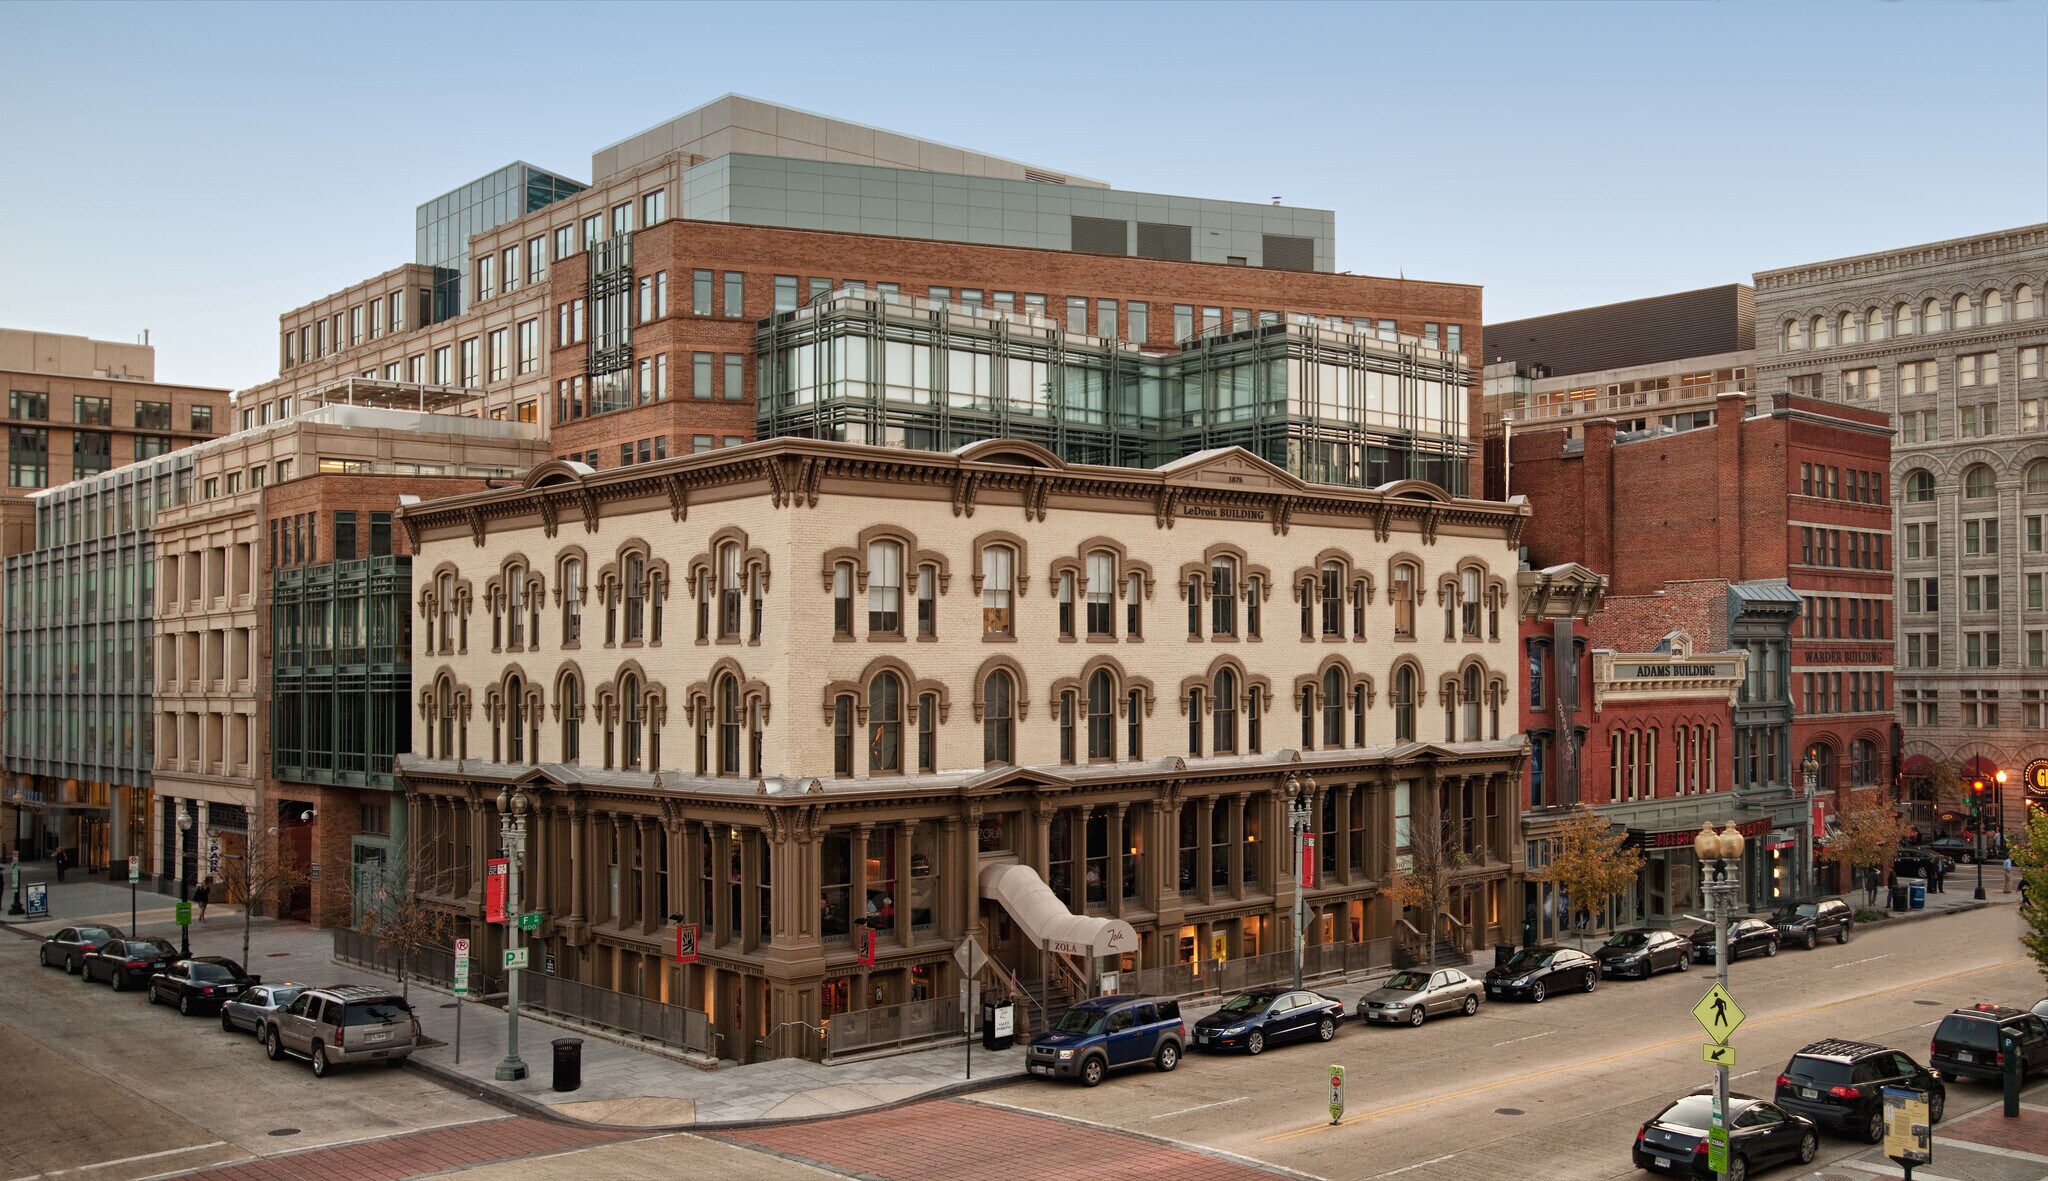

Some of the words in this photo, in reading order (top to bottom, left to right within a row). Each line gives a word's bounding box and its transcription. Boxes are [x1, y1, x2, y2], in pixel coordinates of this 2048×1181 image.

[1228, 475, 1243, 484] 1875
[1183, 505, 1217, 517] LeDroit
[1220, 508, 1264, 520] BUILDING
[1805, 651, 1840, 663] WARDER
[1844, 651, 1882, 662] BUILDING
[1637, 665, 1670, 677] ADAMS
[1673, 665, 1715, 677] BUILDING
[1055, 942, 1077, 953] ZOLA
